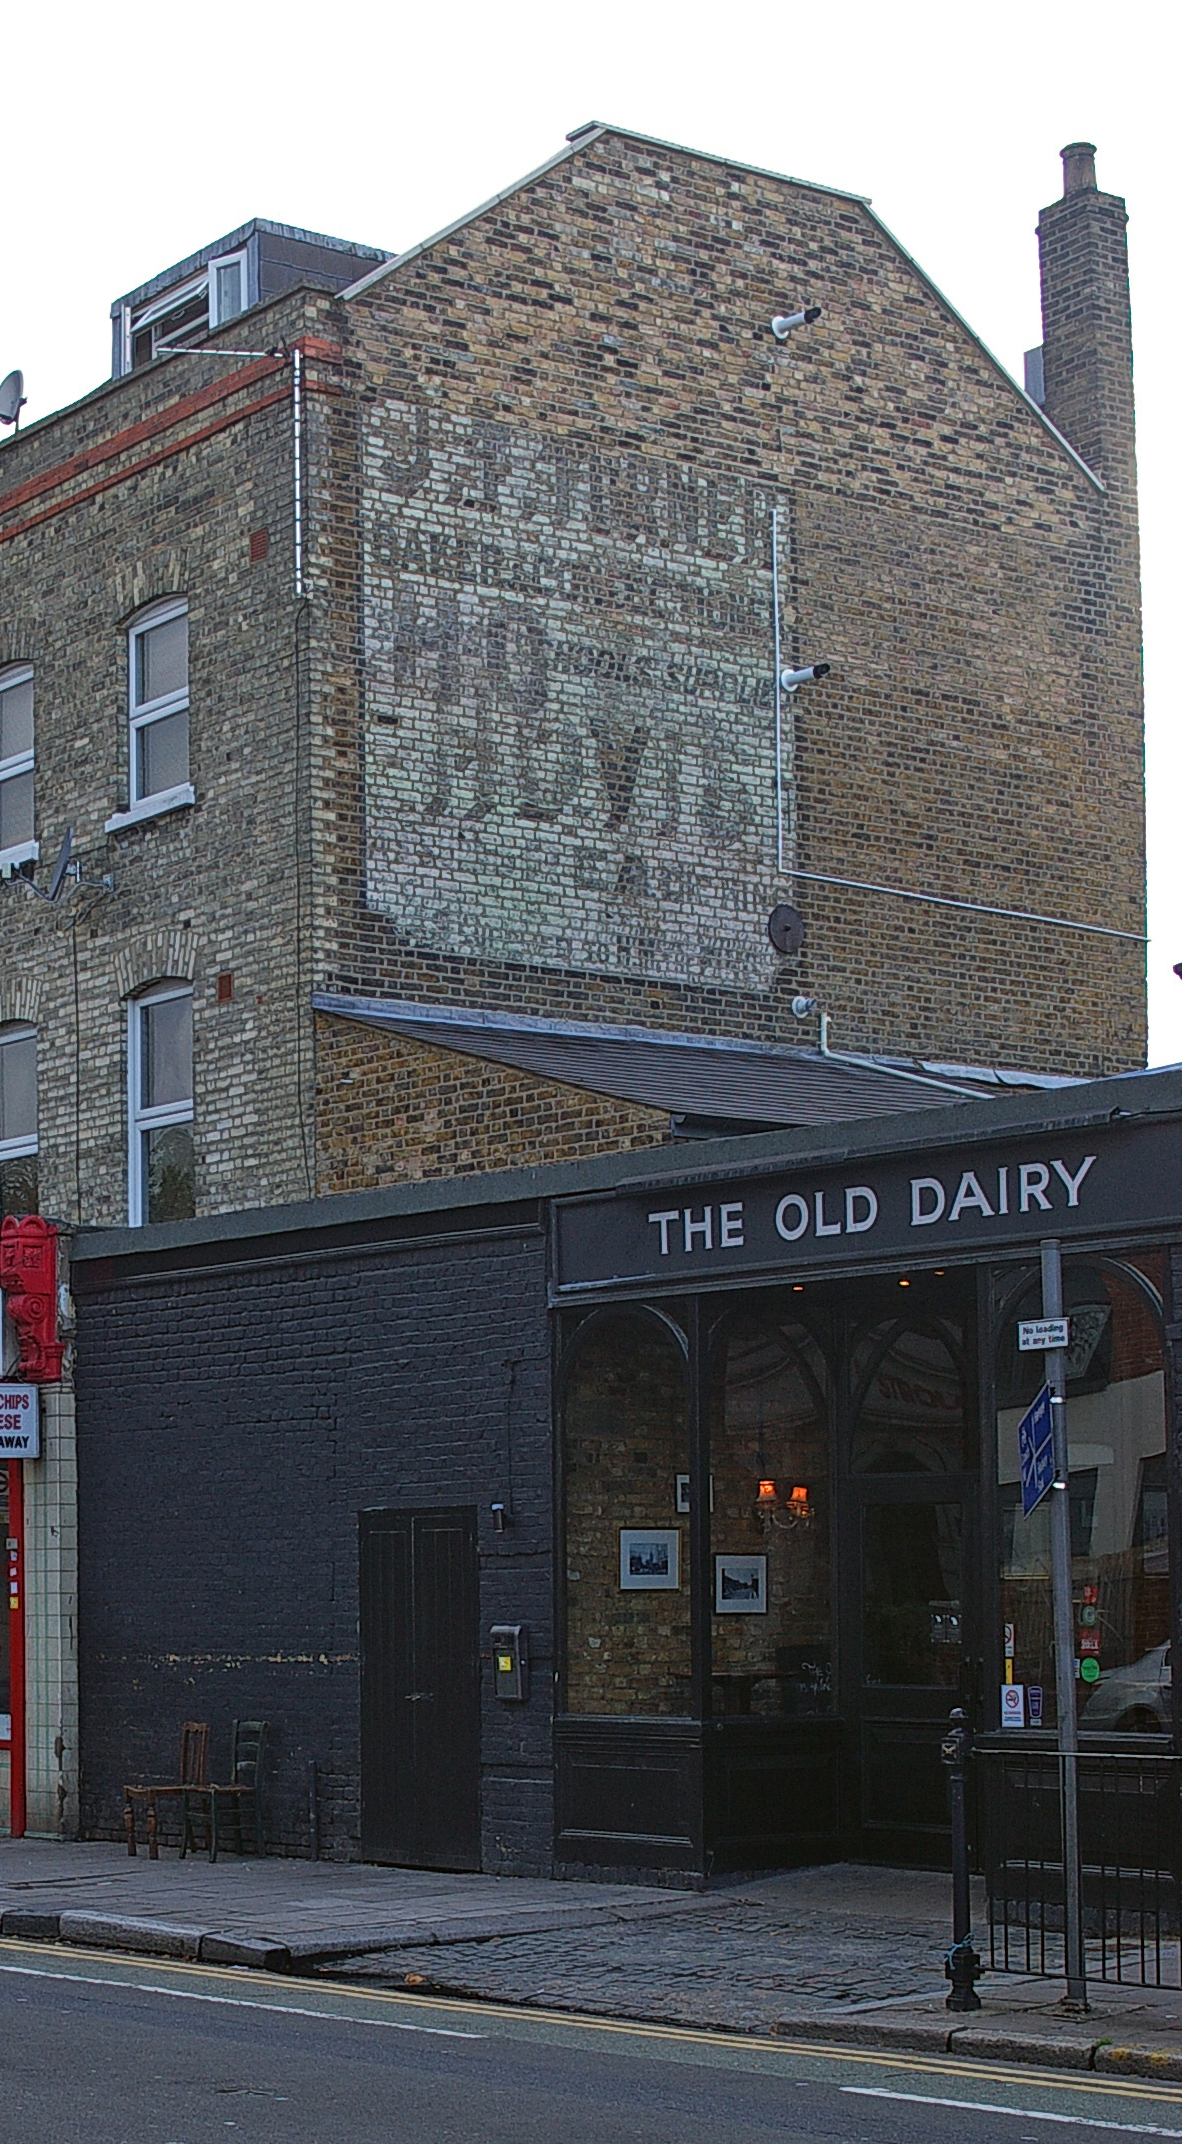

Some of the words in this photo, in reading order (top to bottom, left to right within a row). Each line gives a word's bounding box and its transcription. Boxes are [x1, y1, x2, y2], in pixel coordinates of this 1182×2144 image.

[648, 1201, 745, 1255] THE
[775, 1185, 878, 1241] OLD
[909, 1155, 1097, 1226] DAIRY
[1022, 1326, 1033, 1335] No
[1036, 1323, 1063, 1333] loading
[1022, 1337, 1030, 1345] at
[1048, 1334, 1065, 1343] time
[0, 1393, 30, 1410] CHIPS
